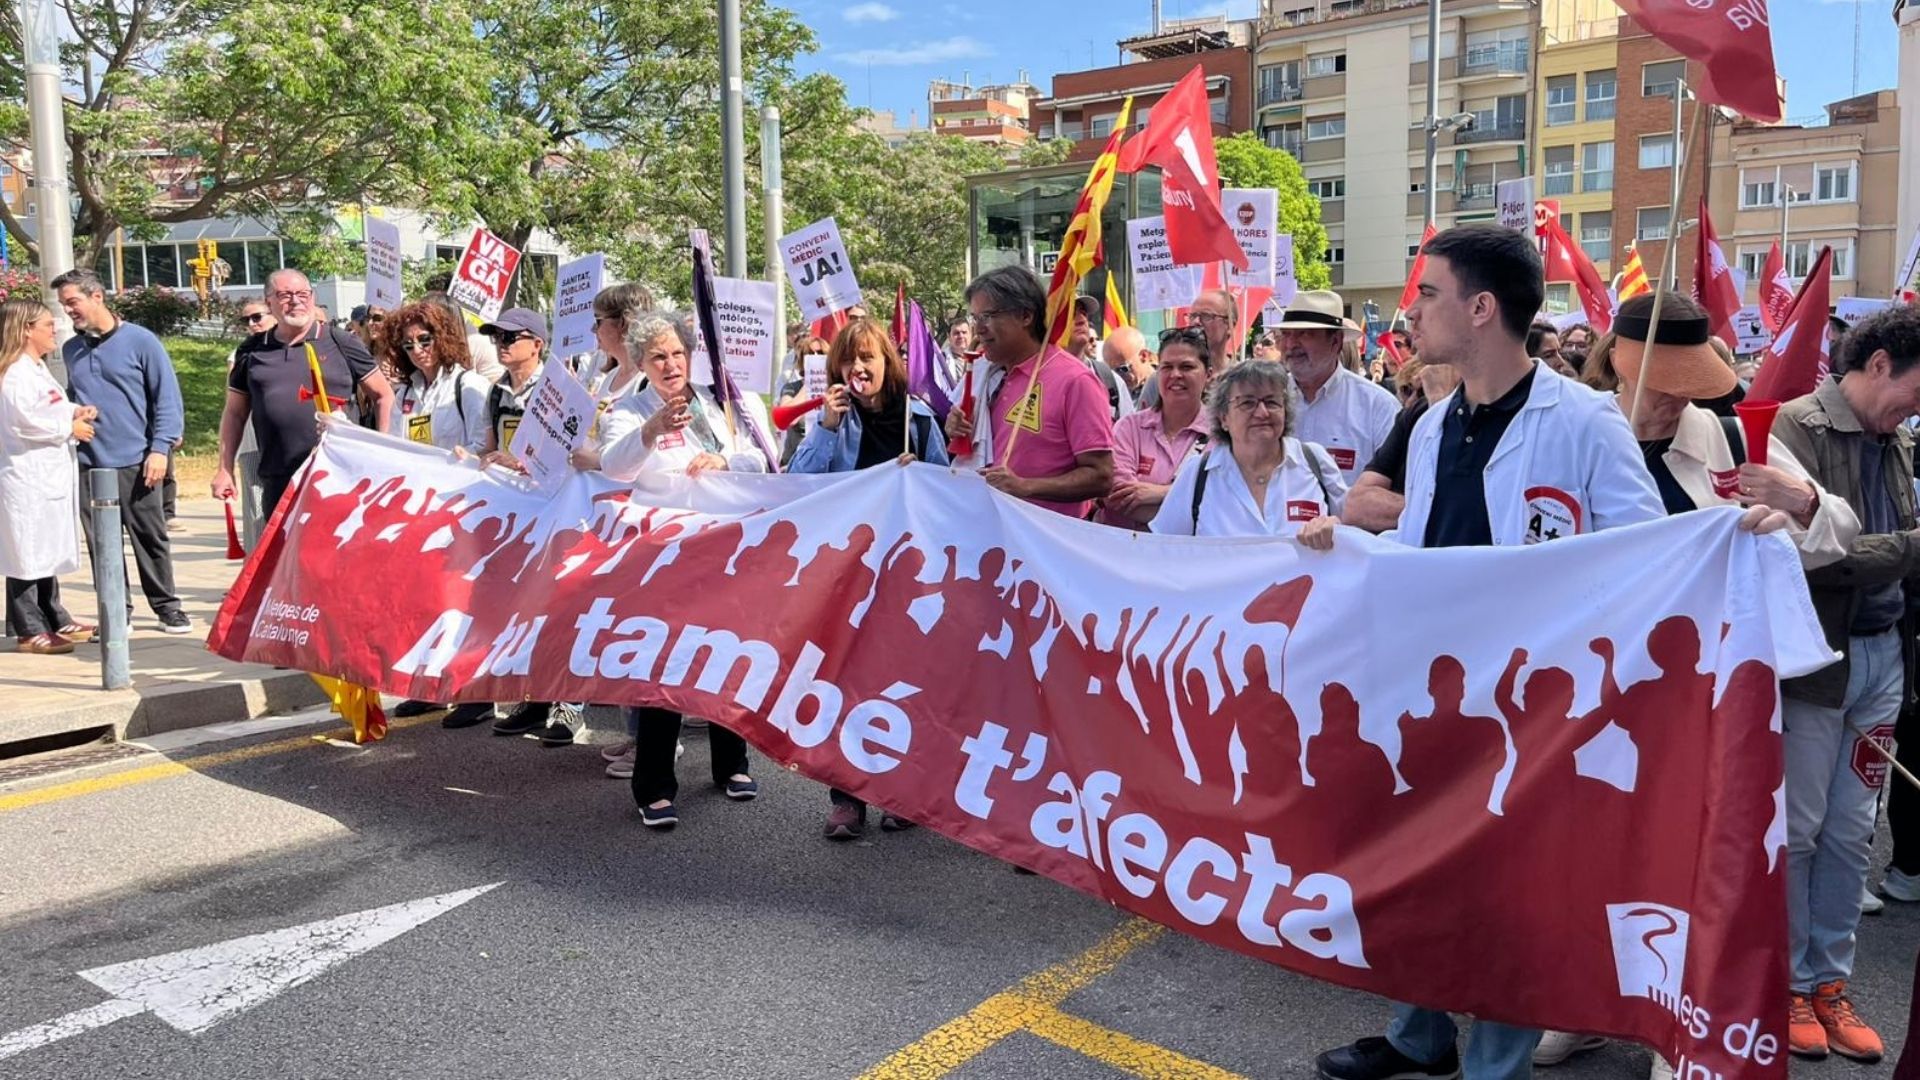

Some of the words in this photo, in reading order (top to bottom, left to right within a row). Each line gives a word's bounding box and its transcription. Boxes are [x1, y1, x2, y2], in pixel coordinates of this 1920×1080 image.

[1502, 201, 1525, 216] Pitjor
[1141, 228, 1166, 237] Metg
[1236, 229, 1268, 238] HORES
[788, 232, 830, 254] CONVENI
[1138, 240, 1168, 250] explot
[1141, 251, 1171, 261] Pacien
[800, 251, 843, 286] JA!
[564, 297, 574, 306] DE
[712, 302, 755, 314] còlegs,
[560, 302, 592, 317] QUALITAT
[720, 313, 762, 325] ntòlegs,
[721, 325, 768, 338] acòlegs,
[736, 337, 758, 346] som
[545, 377, 563, 404] Tanta
[535, 399, 548, 415] ens
[540, 389, 564, 419] espera
[532, 406, 572, 451] desespera
[301, 604, 320, 623] de
[255, 620, 309, 648] Catalunya
[392, 609, 473, 677] A
[472, 612, 548, 679] tu
[569, 597, 923, 774] també
[954, 721, 1371, 969] t’afecta
[1723, 1018, 1778, 1065] de
